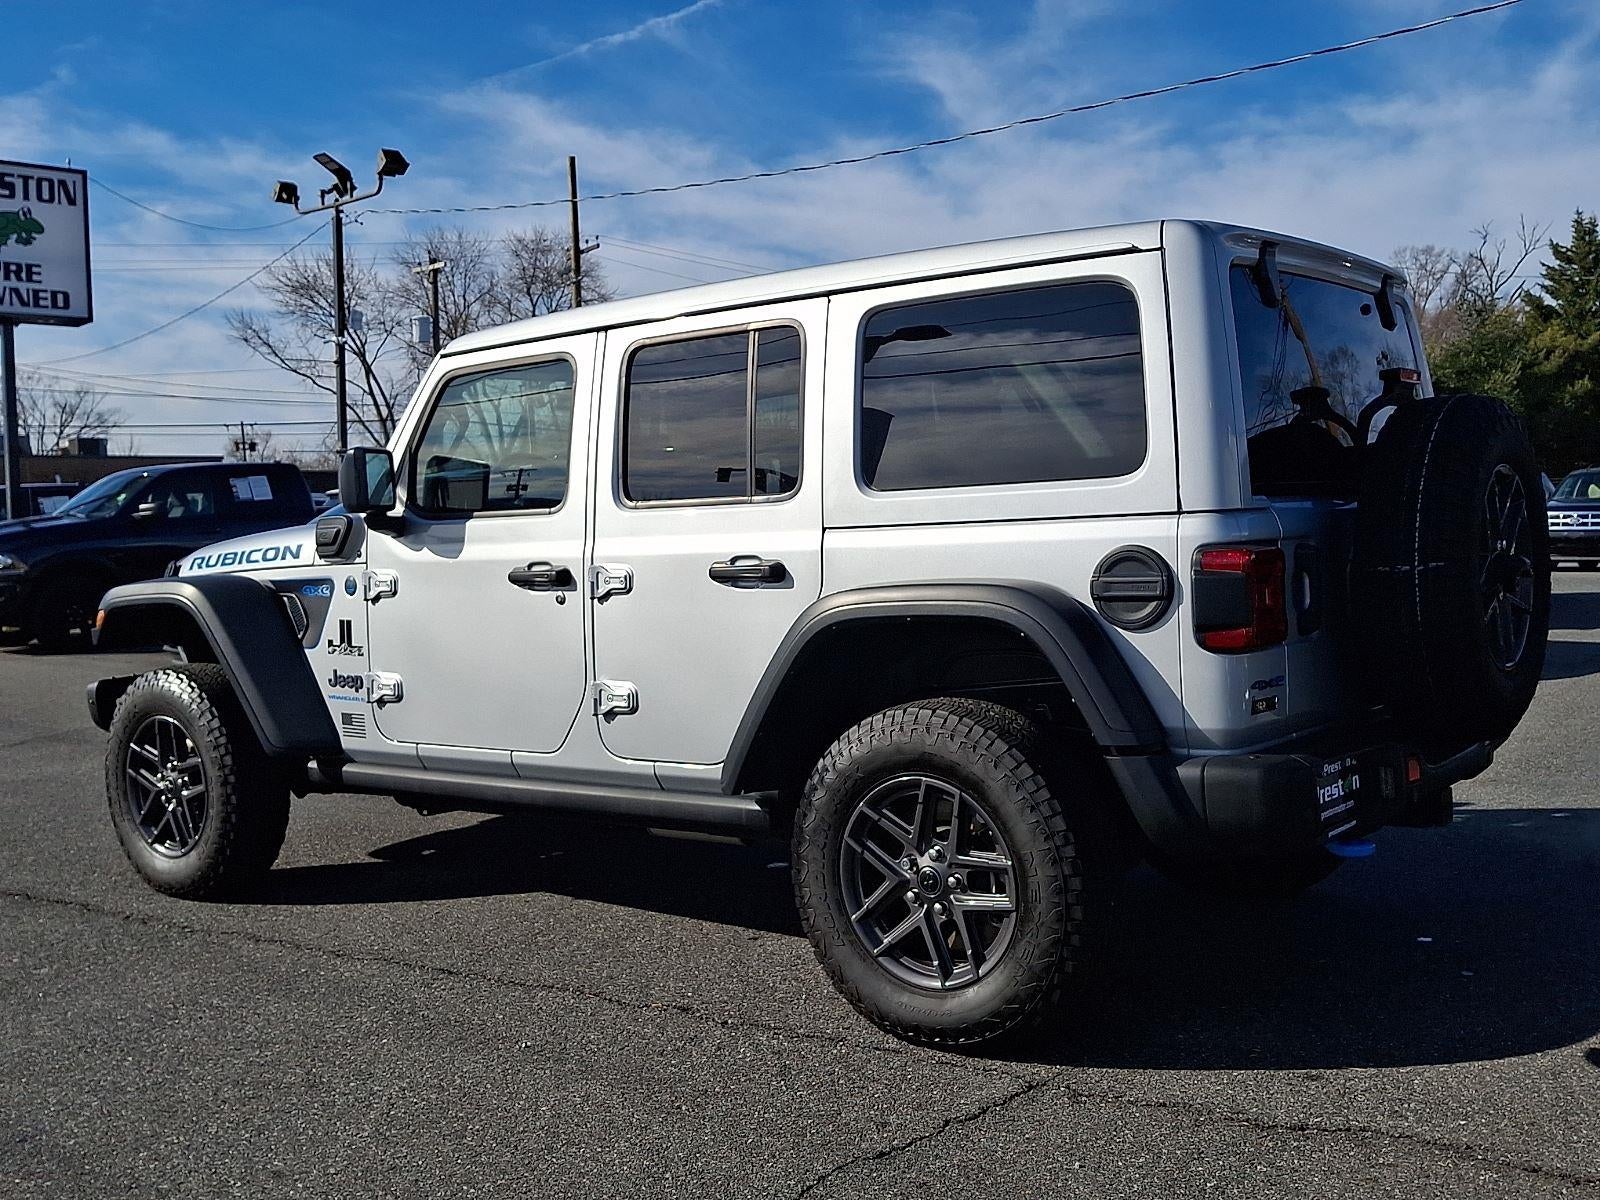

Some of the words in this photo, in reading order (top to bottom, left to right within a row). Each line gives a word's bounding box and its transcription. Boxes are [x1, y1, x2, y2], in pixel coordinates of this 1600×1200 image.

[0, 261, 42, 283] RE
[188, 544, 303, 571] RUBICON
[303, 585, 330, 596] 4xe
[328, 669, 363, 693] Jeep
[1322, 758, 1351, 776] Prestn
[1317, 774, 1359, 804] restn
